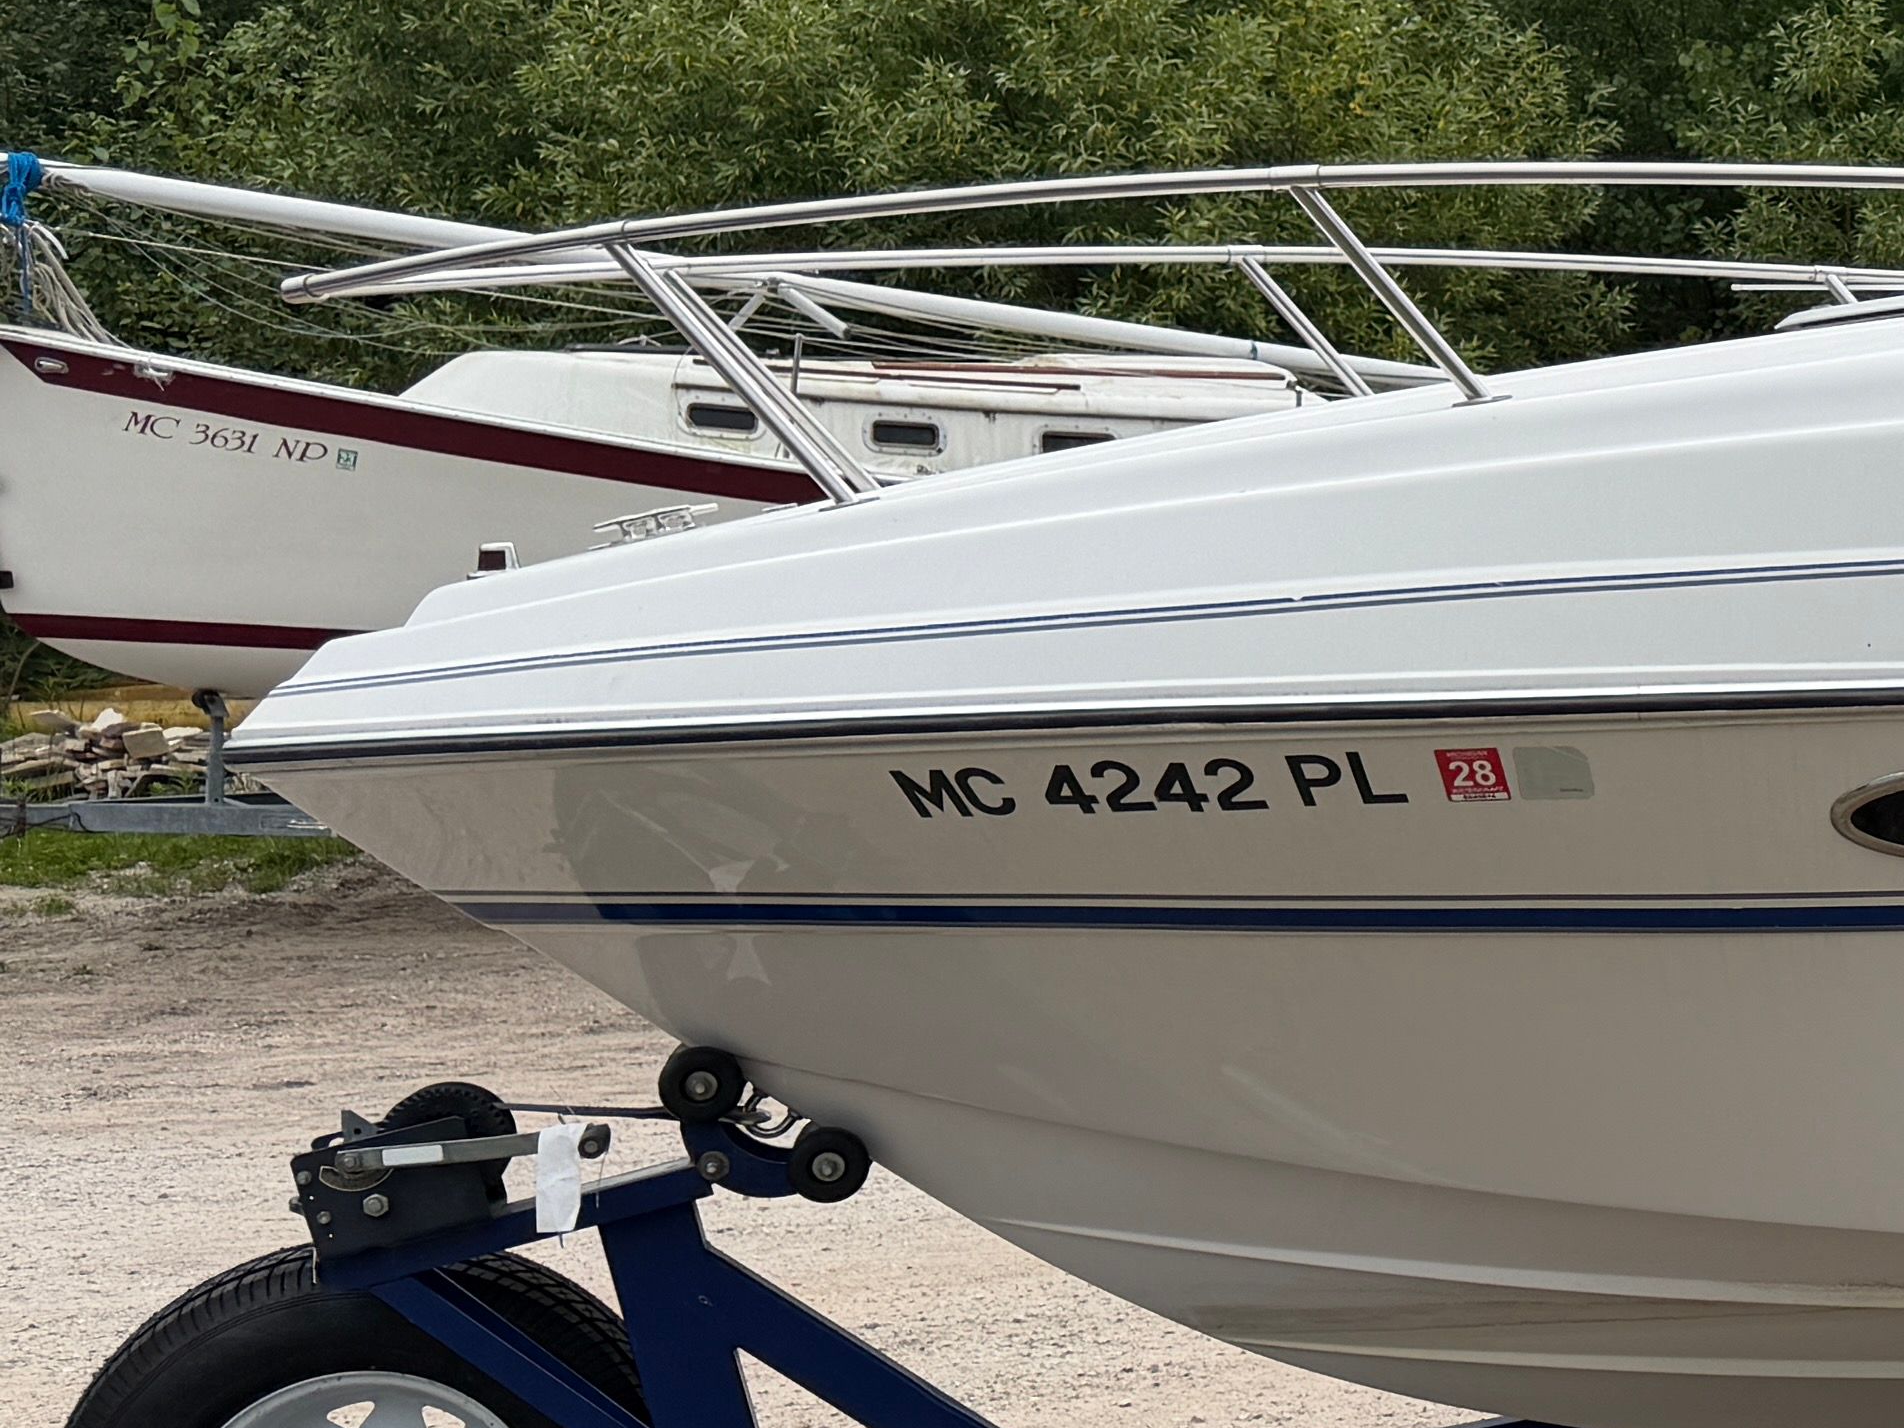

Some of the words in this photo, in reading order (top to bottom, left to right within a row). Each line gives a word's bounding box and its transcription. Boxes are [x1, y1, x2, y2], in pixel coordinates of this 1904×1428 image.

[122, 411, 182, 439] MC
[189, 423, 260, 454] 3631
[272, 437, 329, 463] NP
[888, 767, 1017, 818] MC
[1044, 758, 1270, 814] 4242
[1284, 751, 1410, 807] PL
[1448, 760, 1497, 787] 28
